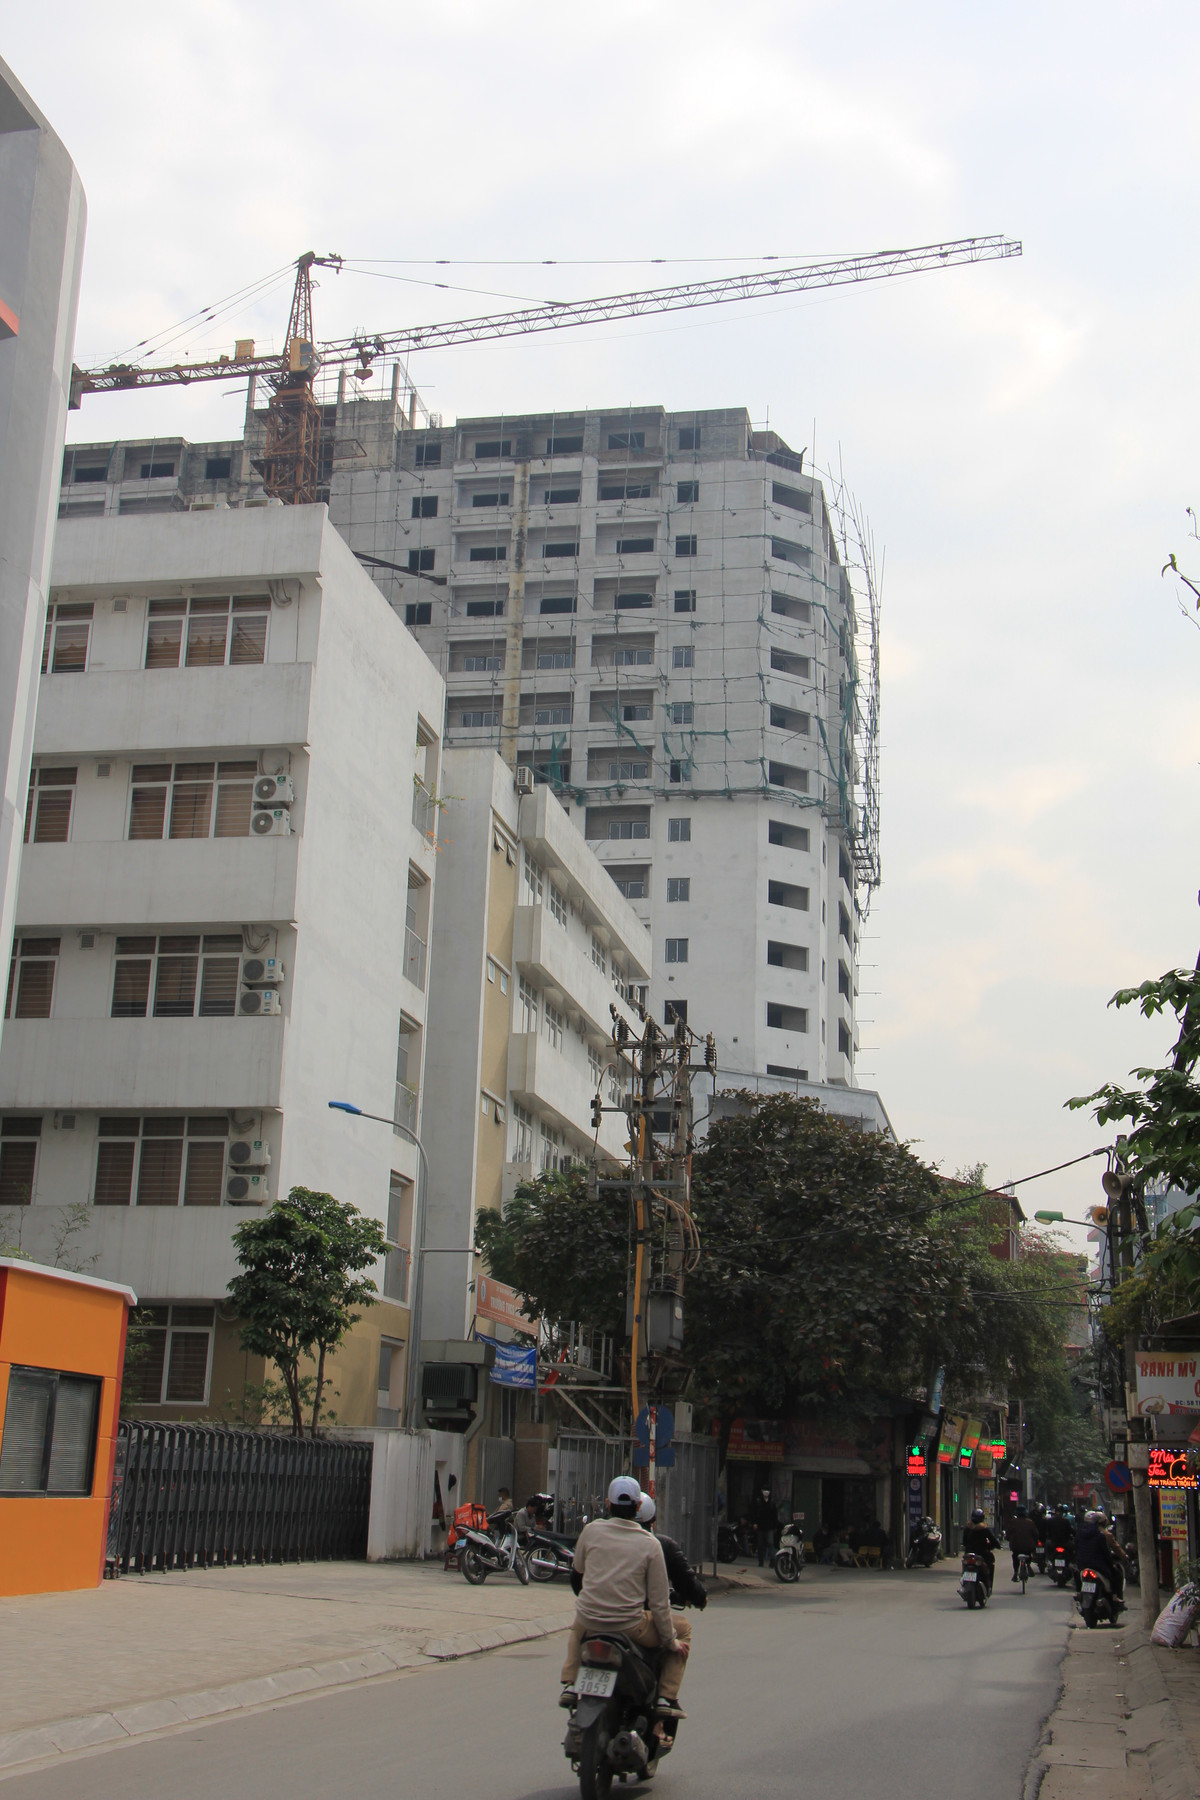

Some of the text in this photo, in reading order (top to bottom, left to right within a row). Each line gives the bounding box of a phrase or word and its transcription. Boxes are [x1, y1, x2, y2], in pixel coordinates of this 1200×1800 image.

[1140, 1359, 1175, 1377] BÁNH
[1148, 1463, 1167, 1476] Tea
[1148, 1478, 1159, 1486] ÁNH
[579, 1681, 607, 1695] 3053
